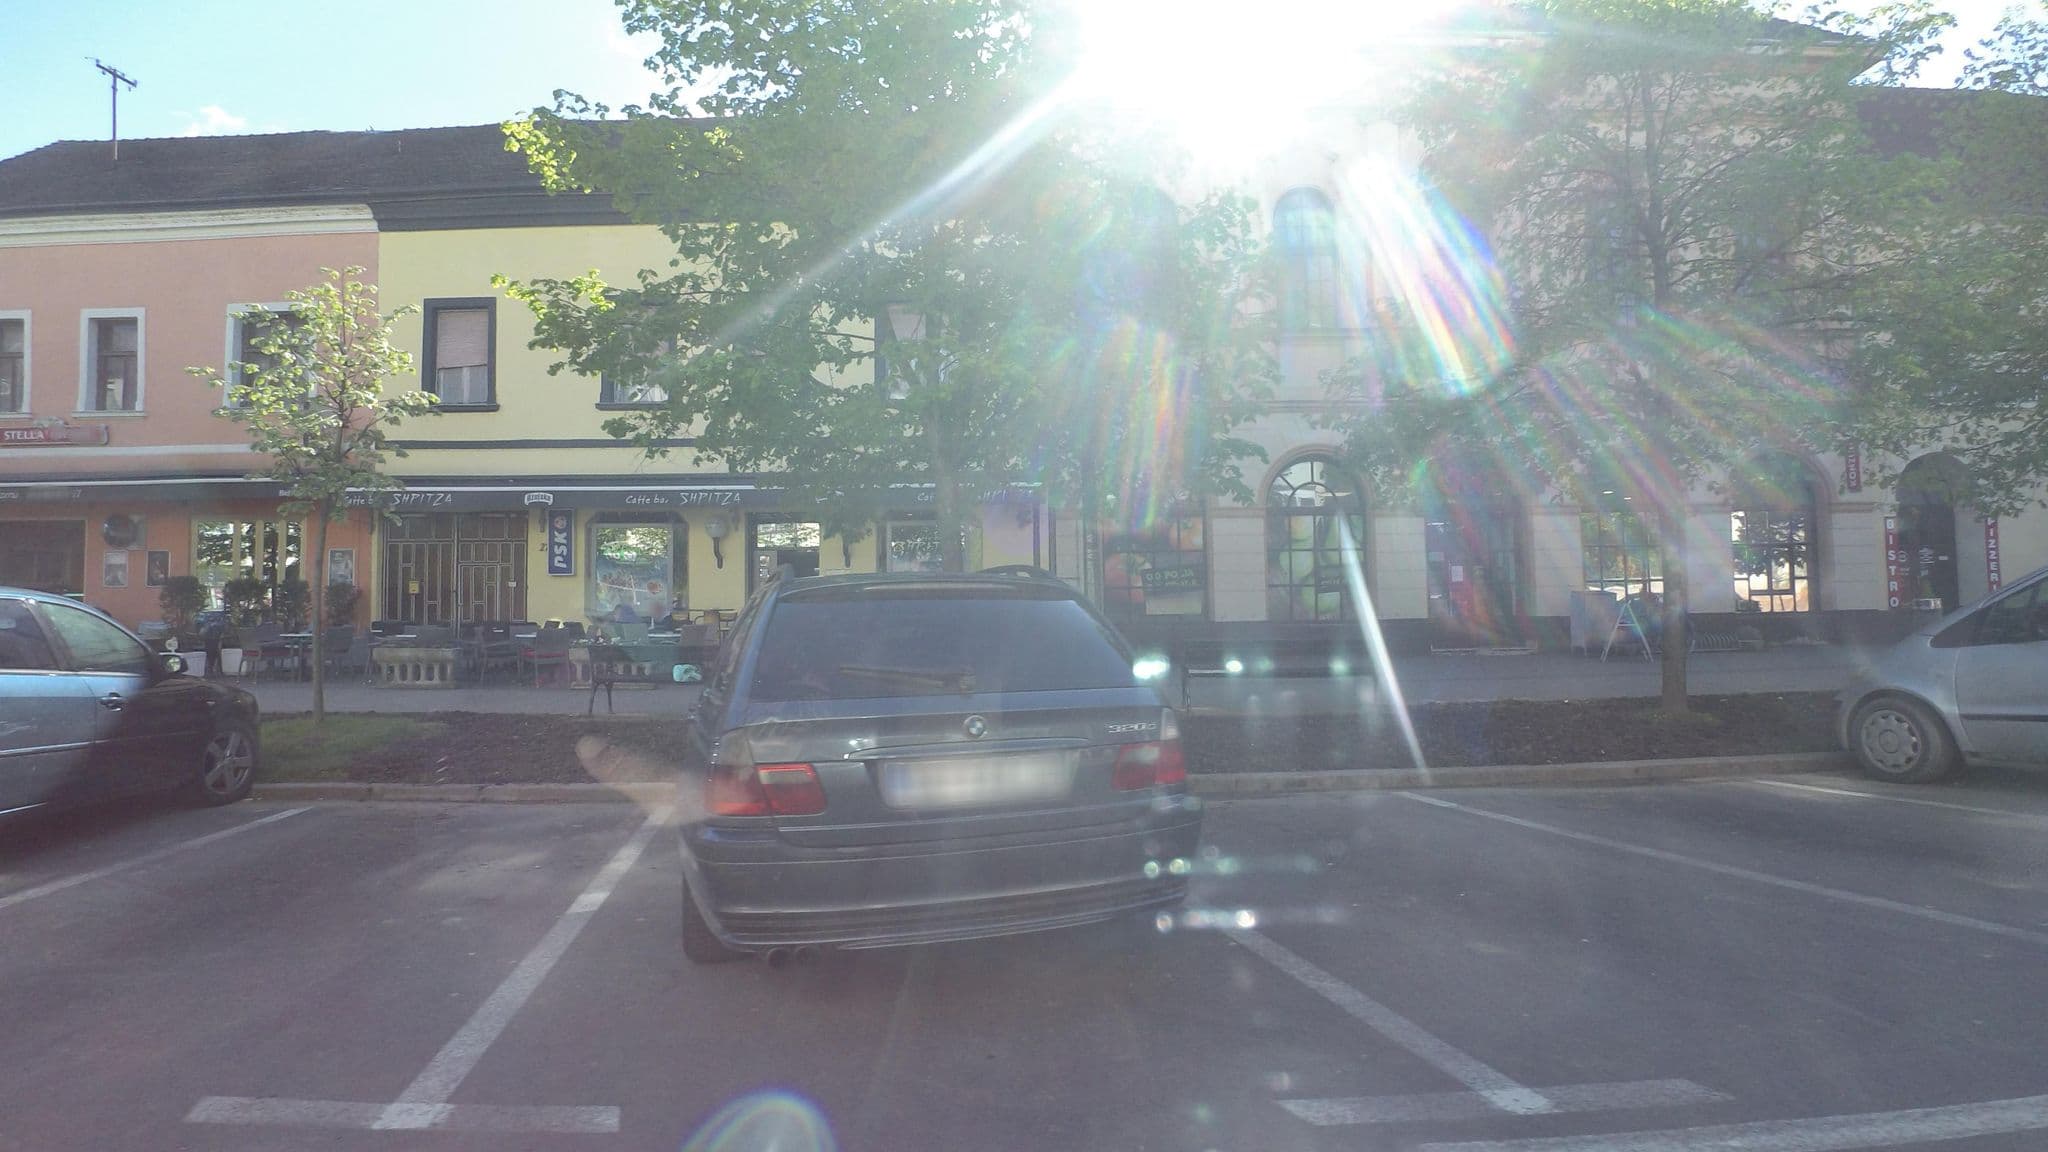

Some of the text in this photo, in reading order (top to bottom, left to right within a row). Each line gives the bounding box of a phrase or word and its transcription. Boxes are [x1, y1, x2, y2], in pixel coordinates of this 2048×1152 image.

[4, 430, 45, 441] STELLA
[392, 493, 453, 506] SHPITZA
[680, 492, 742, 506] SHPITZA
[553, 530, 568, 568] PSK
[1886, 518, 1900, 608] BISTRO
